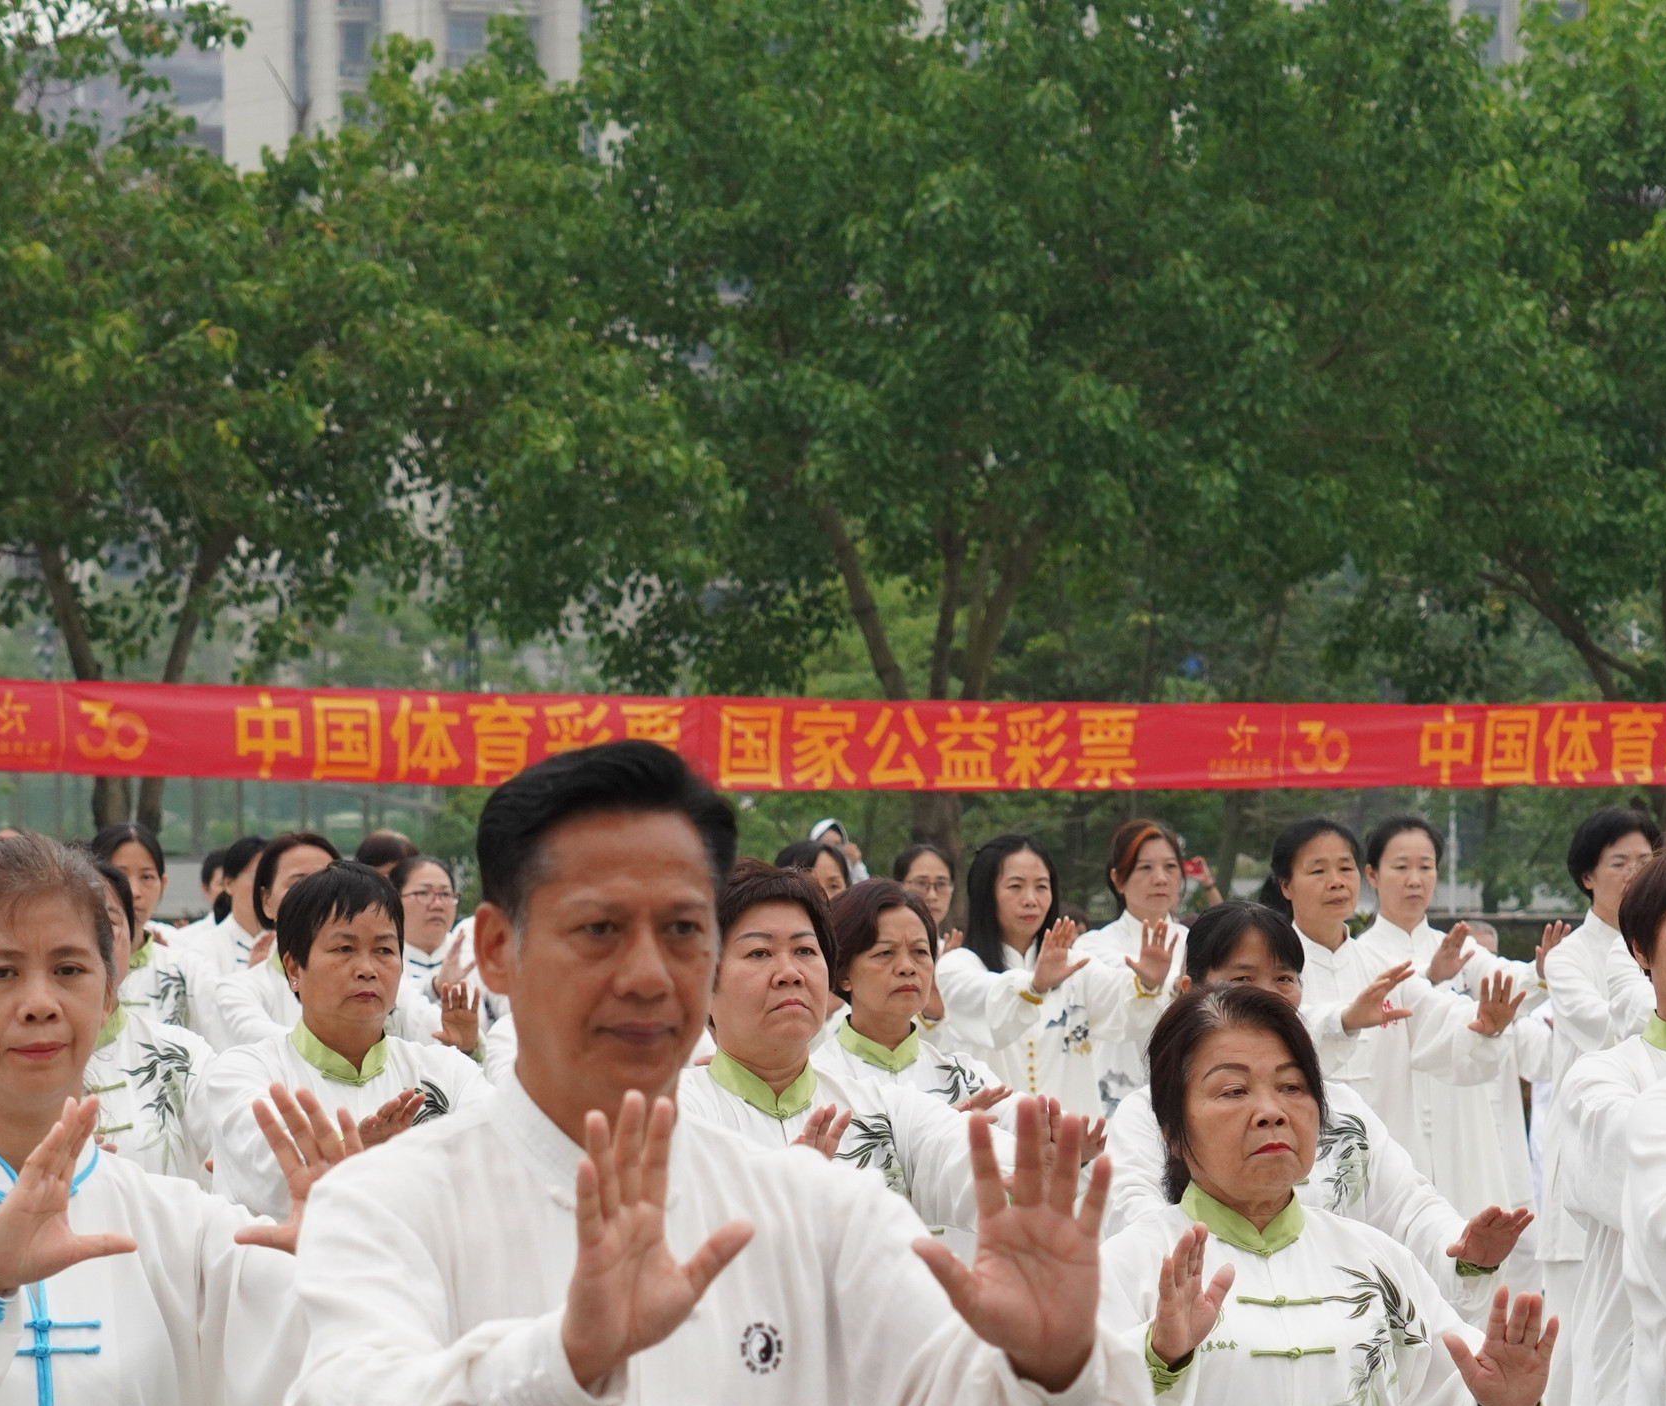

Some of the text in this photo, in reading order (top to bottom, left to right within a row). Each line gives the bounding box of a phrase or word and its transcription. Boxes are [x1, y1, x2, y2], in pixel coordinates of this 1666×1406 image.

[75, 700, 149, 761] 30
[718, 703, 1138, 789] 国家公益彩票
[1291, 720, 1350, 774] 30
